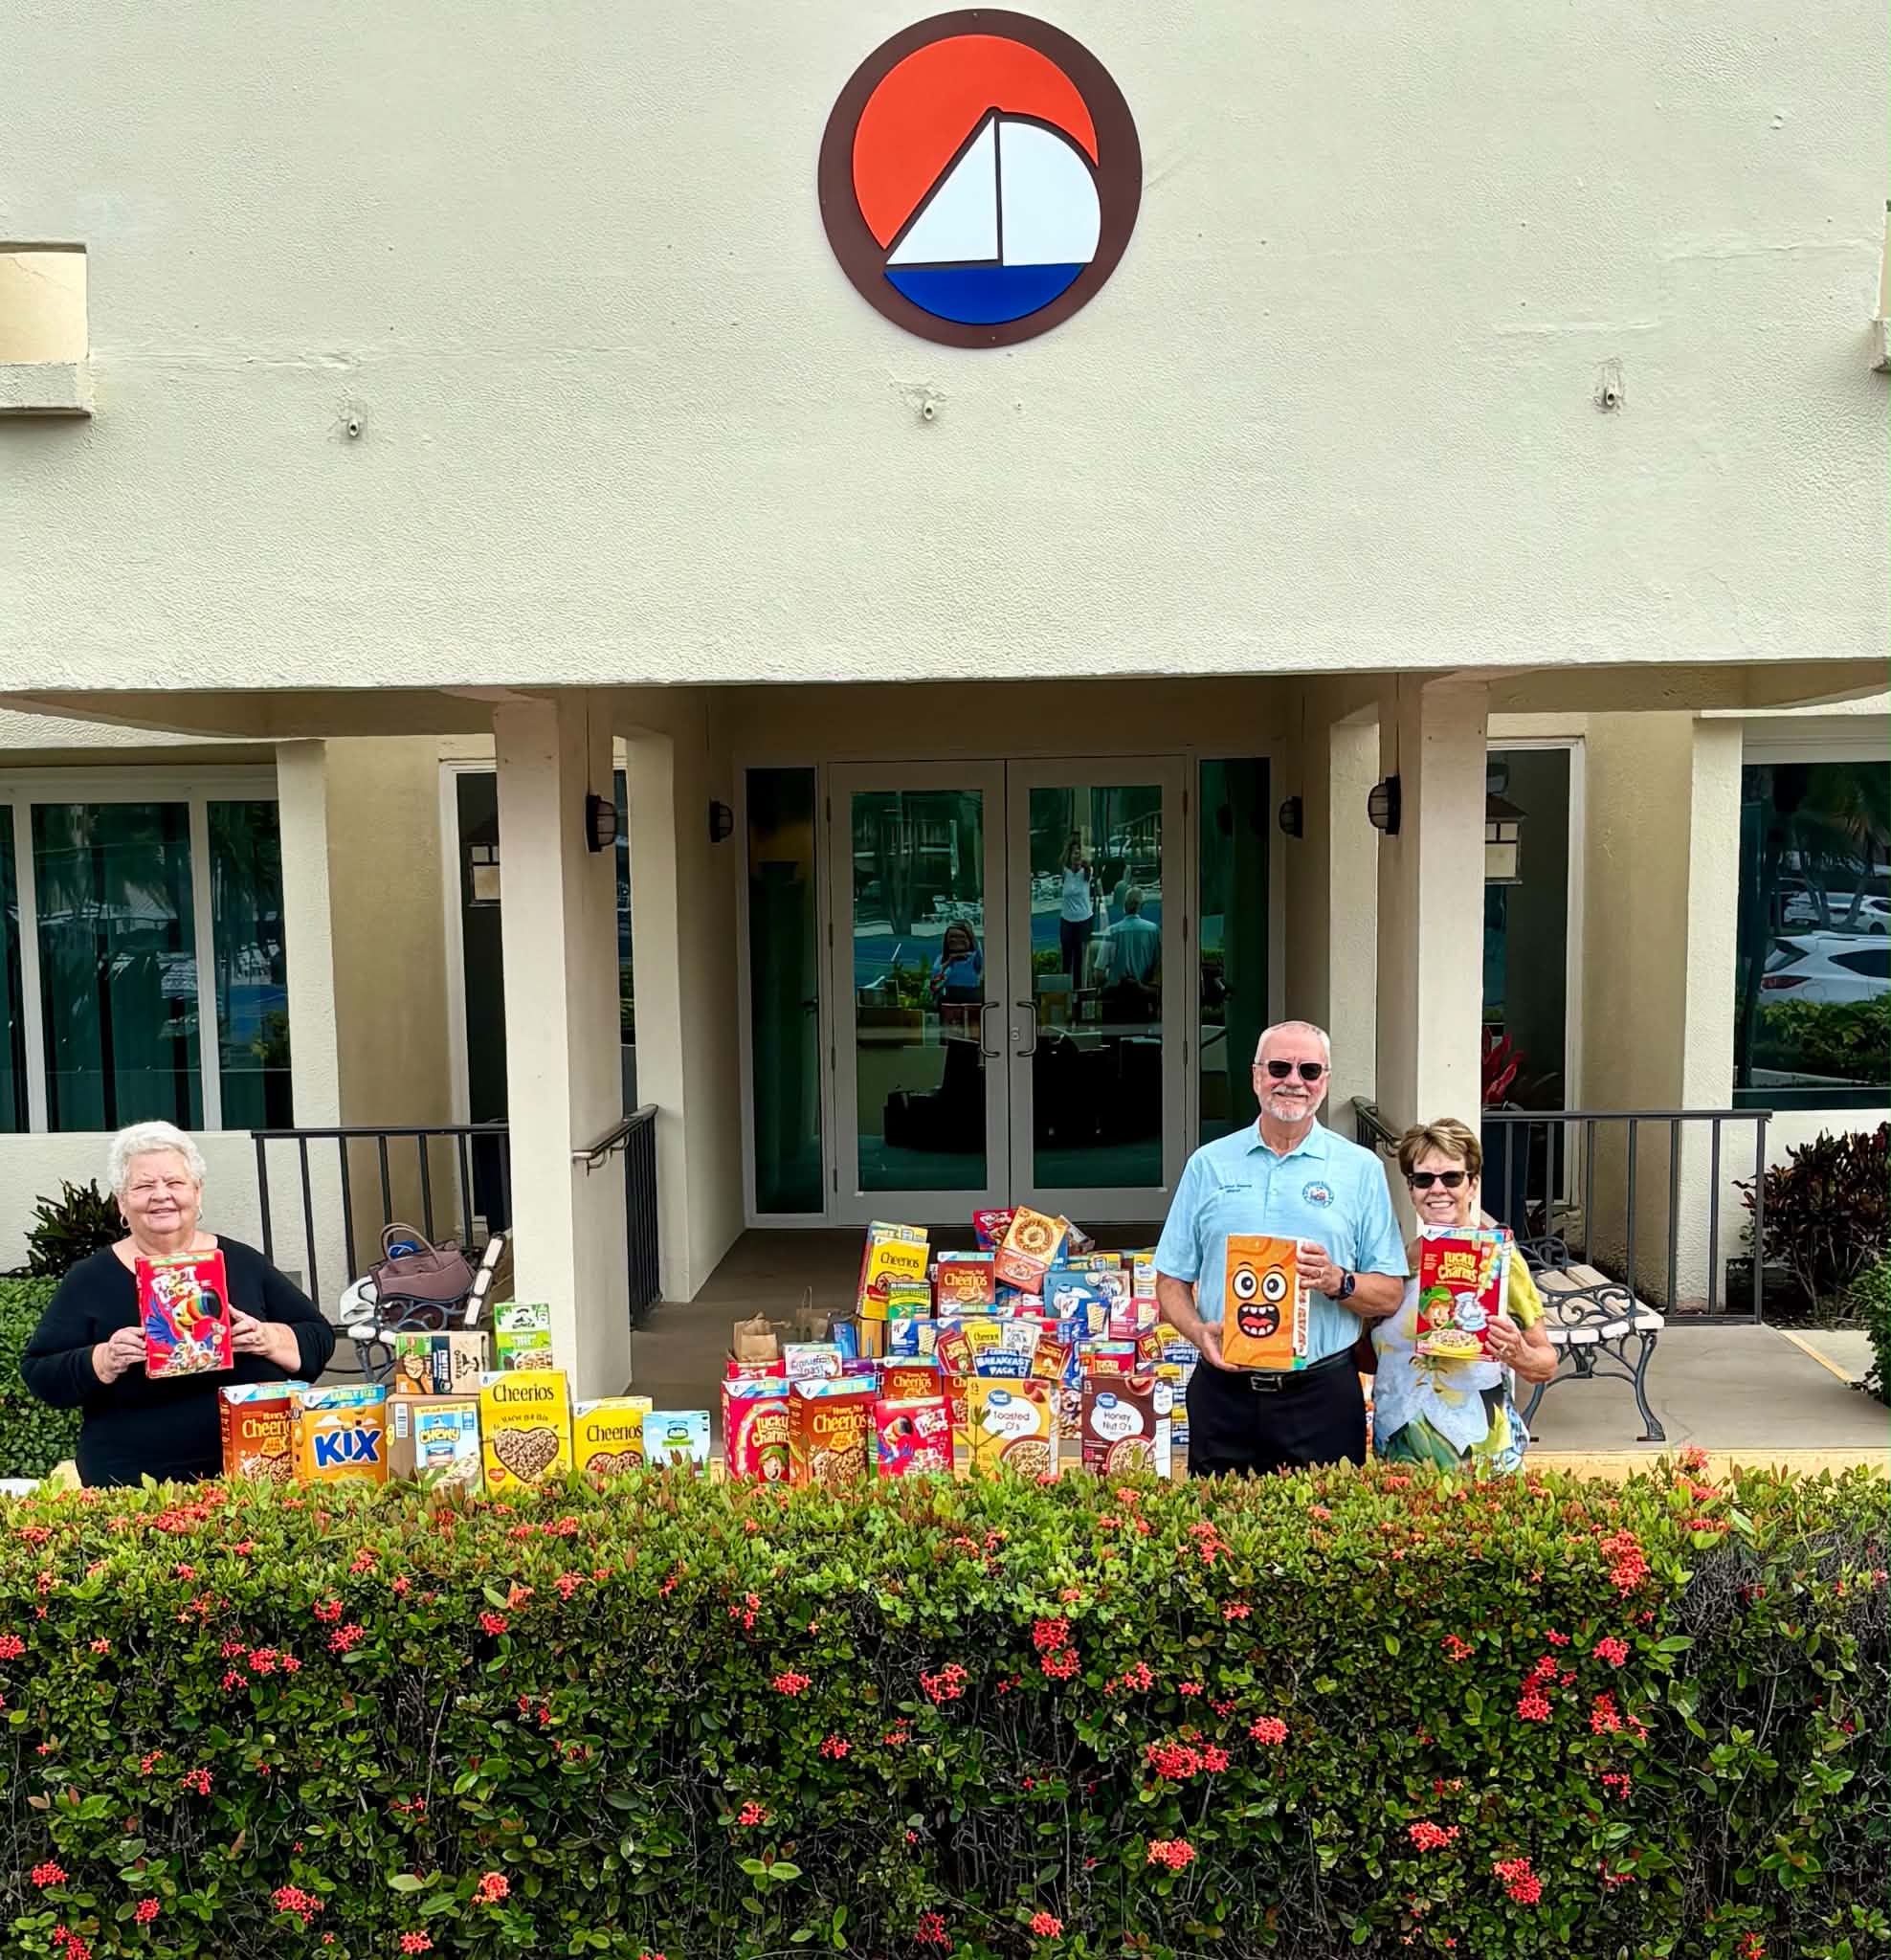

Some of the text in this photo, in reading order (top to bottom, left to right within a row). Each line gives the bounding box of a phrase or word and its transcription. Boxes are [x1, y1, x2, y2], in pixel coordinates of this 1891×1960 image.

[880, 1252, 920, 1269] Cheerios
[944, 1273, 988, 1287] Cheerios
[976, 1356, 1031, 1365] BREAKFAST
[990, 1367, 1016, 1375] PACK
[893, 1376, 932, 1388] Cheerios
[493, 1384, 555, 1403] Cheerios
[812, 1413, 868, 1434] Cheerios
[993, 1412, 1031, 1422] Toasted
[1103, 1412, 1132, 1424] Honey
[587, 1424, 643, 1443] Cheerios
[1102, 1422, 1118, 1432] Nut
[419, 1426, 460, 1444] CHEWY
[314, 1429, 381, 1468] KIX
